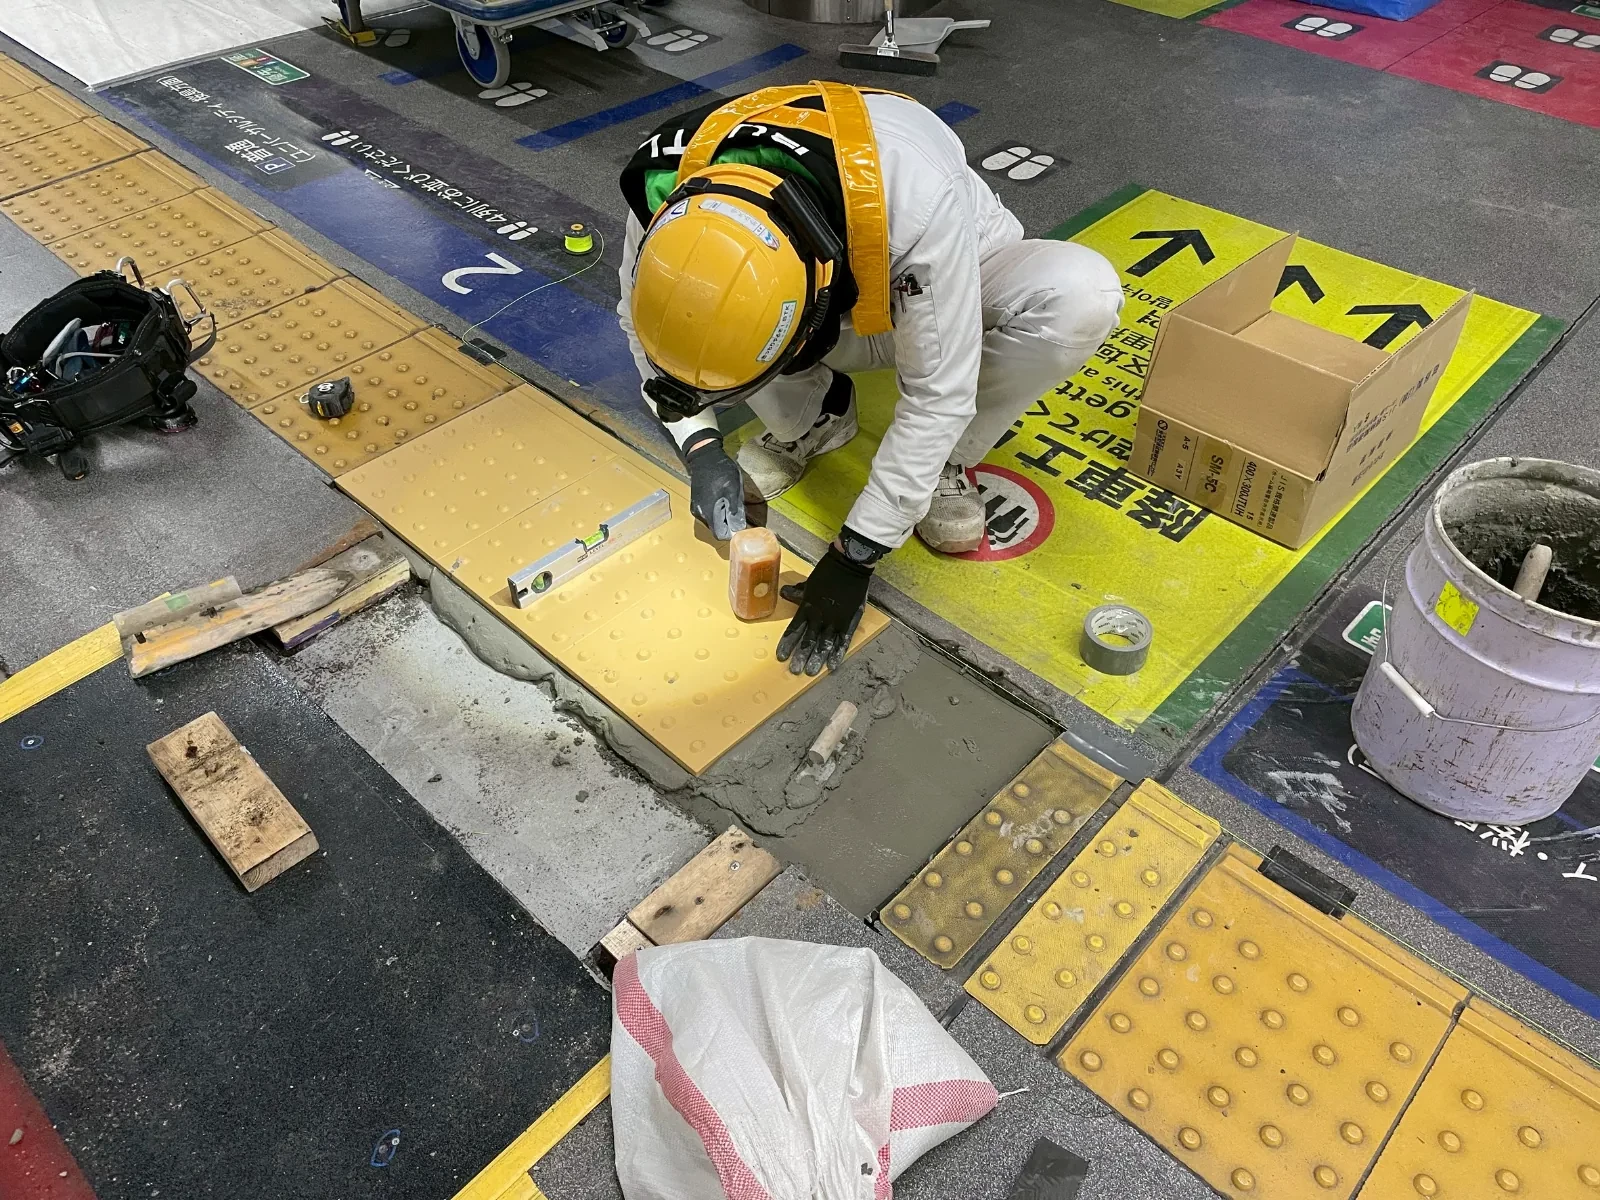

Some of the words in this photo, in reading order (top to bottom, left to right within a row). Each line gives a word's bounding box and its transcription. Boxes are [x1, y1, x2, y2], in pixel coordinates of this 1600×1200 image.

[224, 138, 274, 163] 普通
[350, 141, 507, 223] 4列にお並びください
[441, 252, 523, 295] 2
[1055, 380, 1138, 419] gett
[1101, 375, 1142, 401] this
[1204, 454, 1224, 493] SM-5C
[1246, 511, 1255, 521] 15
